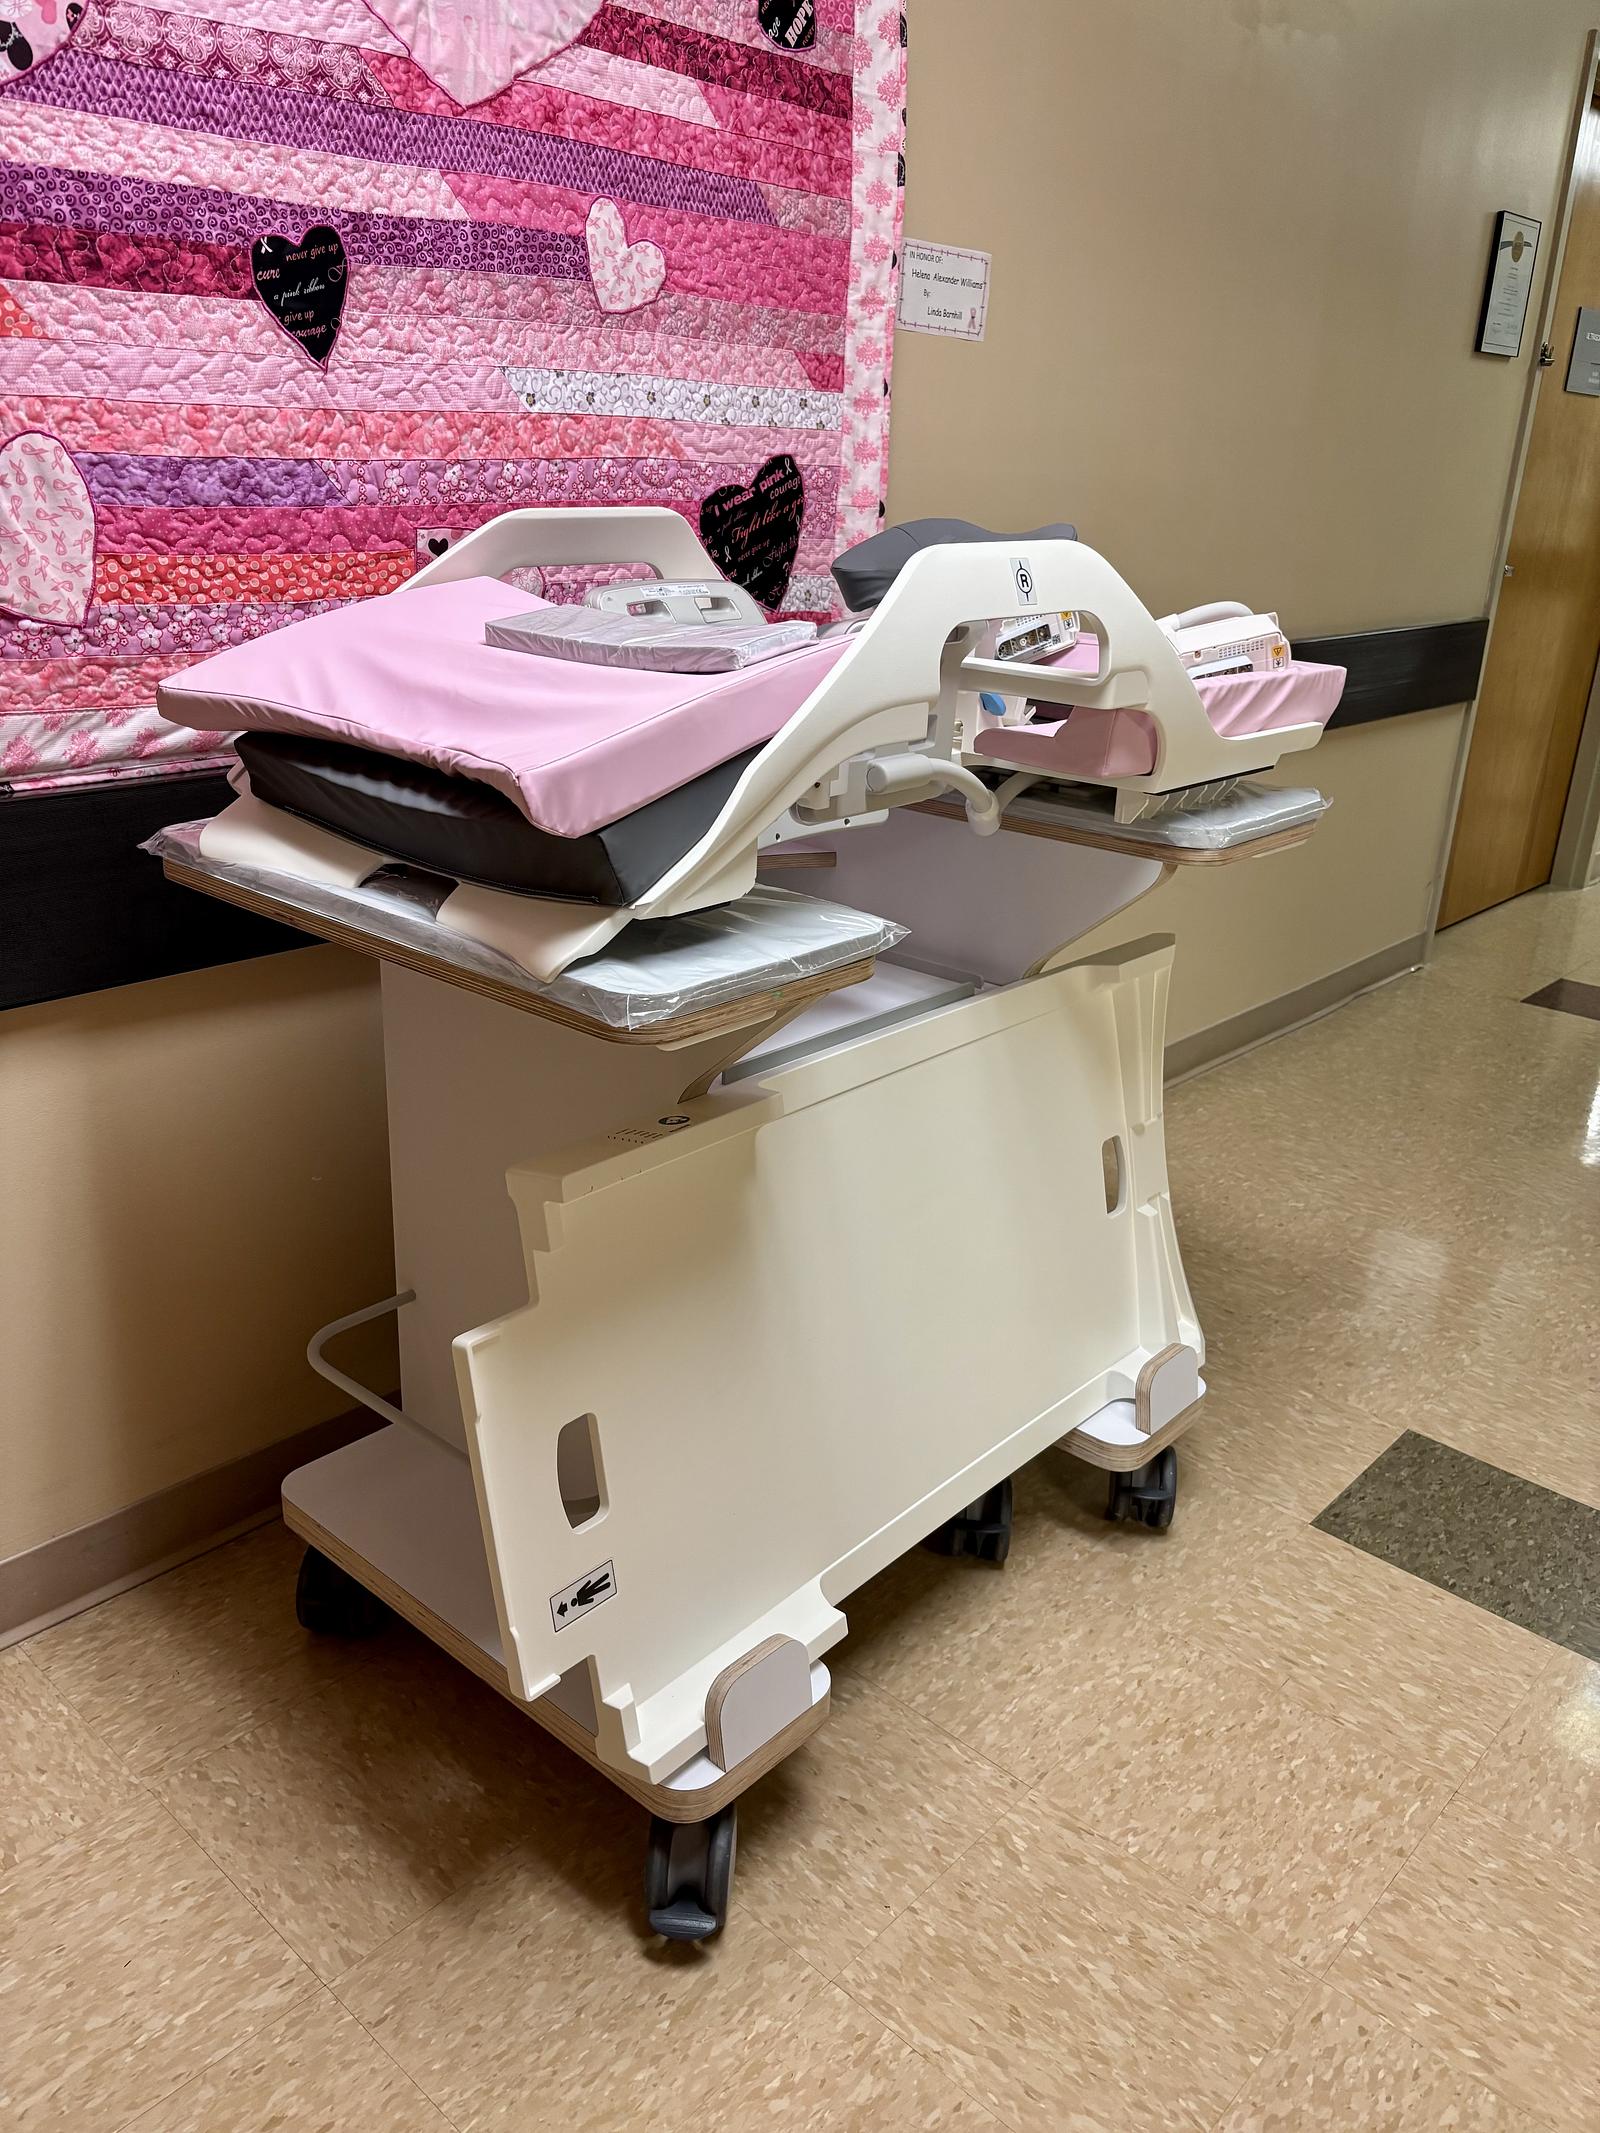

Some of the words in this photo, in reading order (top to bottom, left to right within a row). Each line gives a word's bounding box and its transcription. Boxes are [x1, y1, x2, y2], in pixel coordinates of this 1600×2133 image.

[285, 250, 308, 262] never
[310, 243, 326, 260] give
[328, 243, 339, 255] up
[909, 250, 915, 258] IN
[916, 252, 935, 263] HONOR
[256, 268, 281, 281] cure
[912, 268, 931, 280] Helena
[933, 272, 959, 286] Alexander
[960, 277, 984, 290] Williams
[280, 281, 302, 307] pink
[303, 277, 326, 295] ribbon
[284, 311, 303, 326] give
[304, 309, 315, 322] up
[927, 306, 942, 318] Linda
[942, 308, 963, 320] Barnhill
[722, 487, 756, 512] wear
[759, 468, 785, 494] pink
[731, 511, 761, 550] Fight
[762, 500, 782, 526] like
[1020, 574, 1029, 588] R
